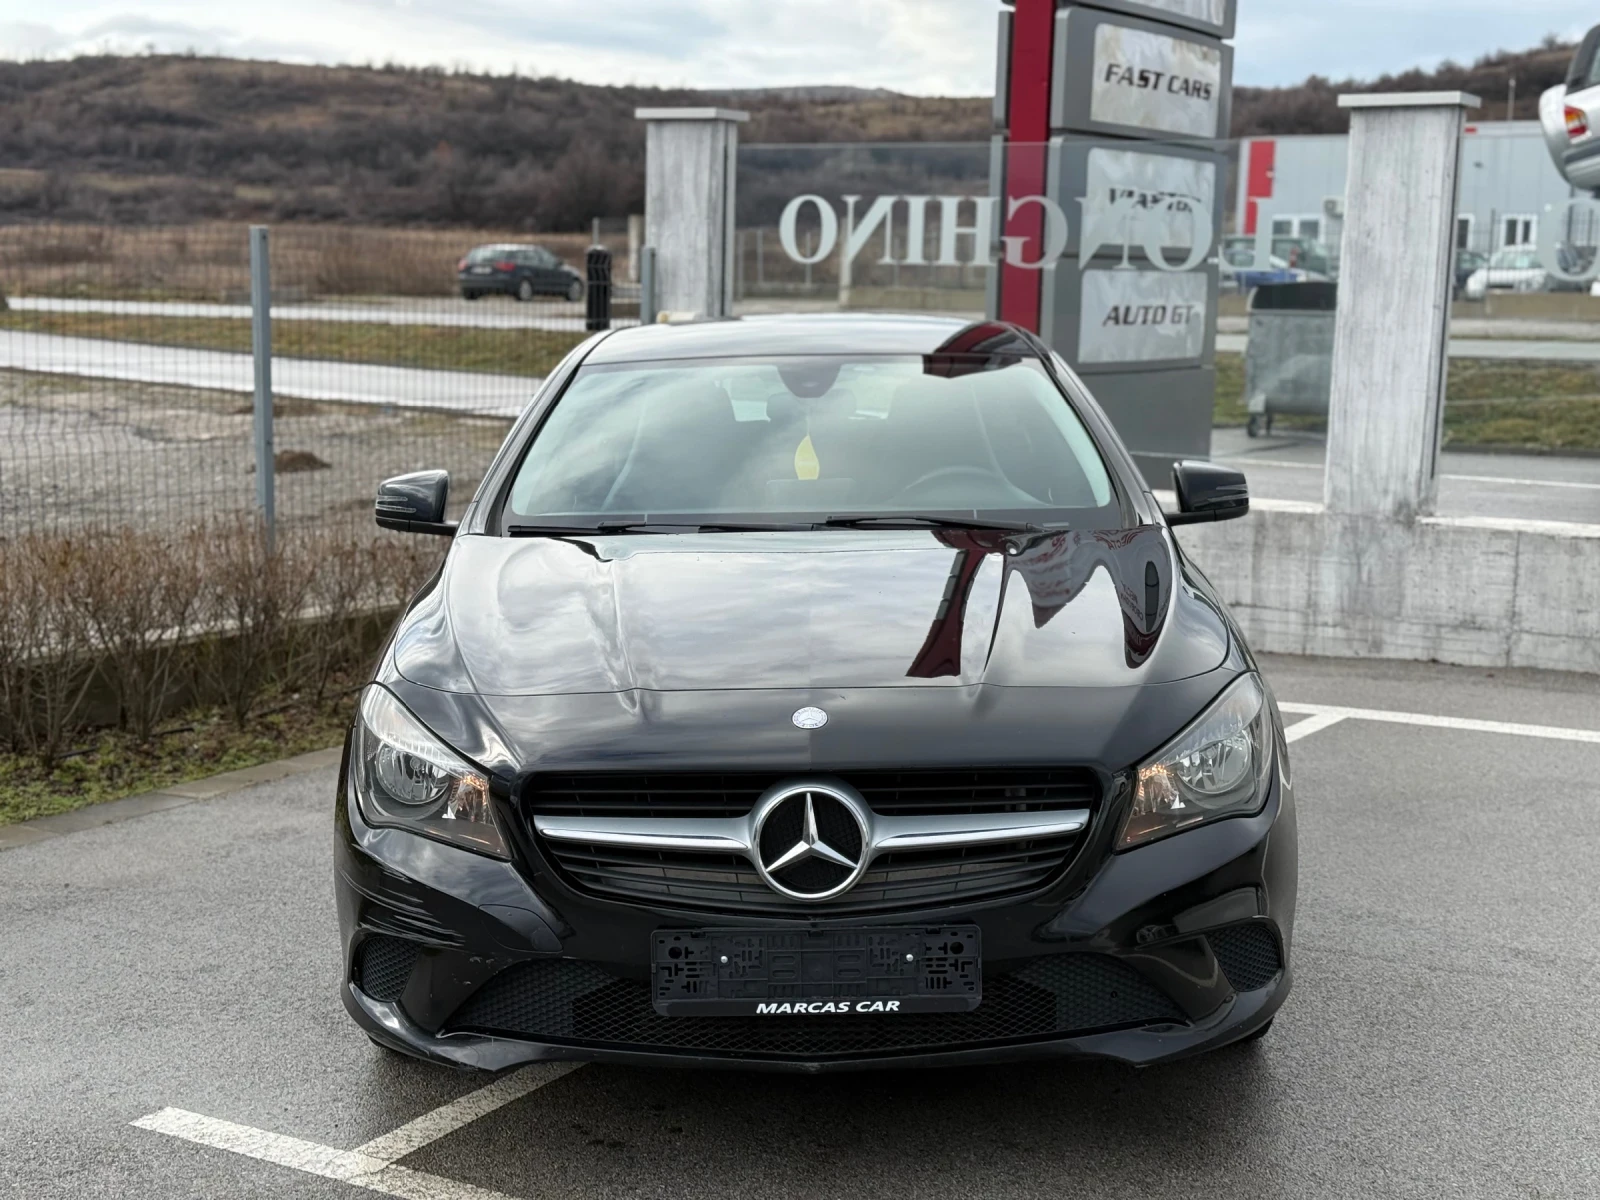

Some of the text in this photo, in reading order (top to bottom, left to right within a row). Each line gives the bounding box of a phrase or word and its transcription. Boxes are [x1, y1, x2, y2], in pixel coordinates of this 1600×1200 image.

[1104, 63, 1213, 101] FAST CARS
[1102, 304, 1195, 327] AUTO GT
[755, 1000, 901, 1014] MARCAS CAR
